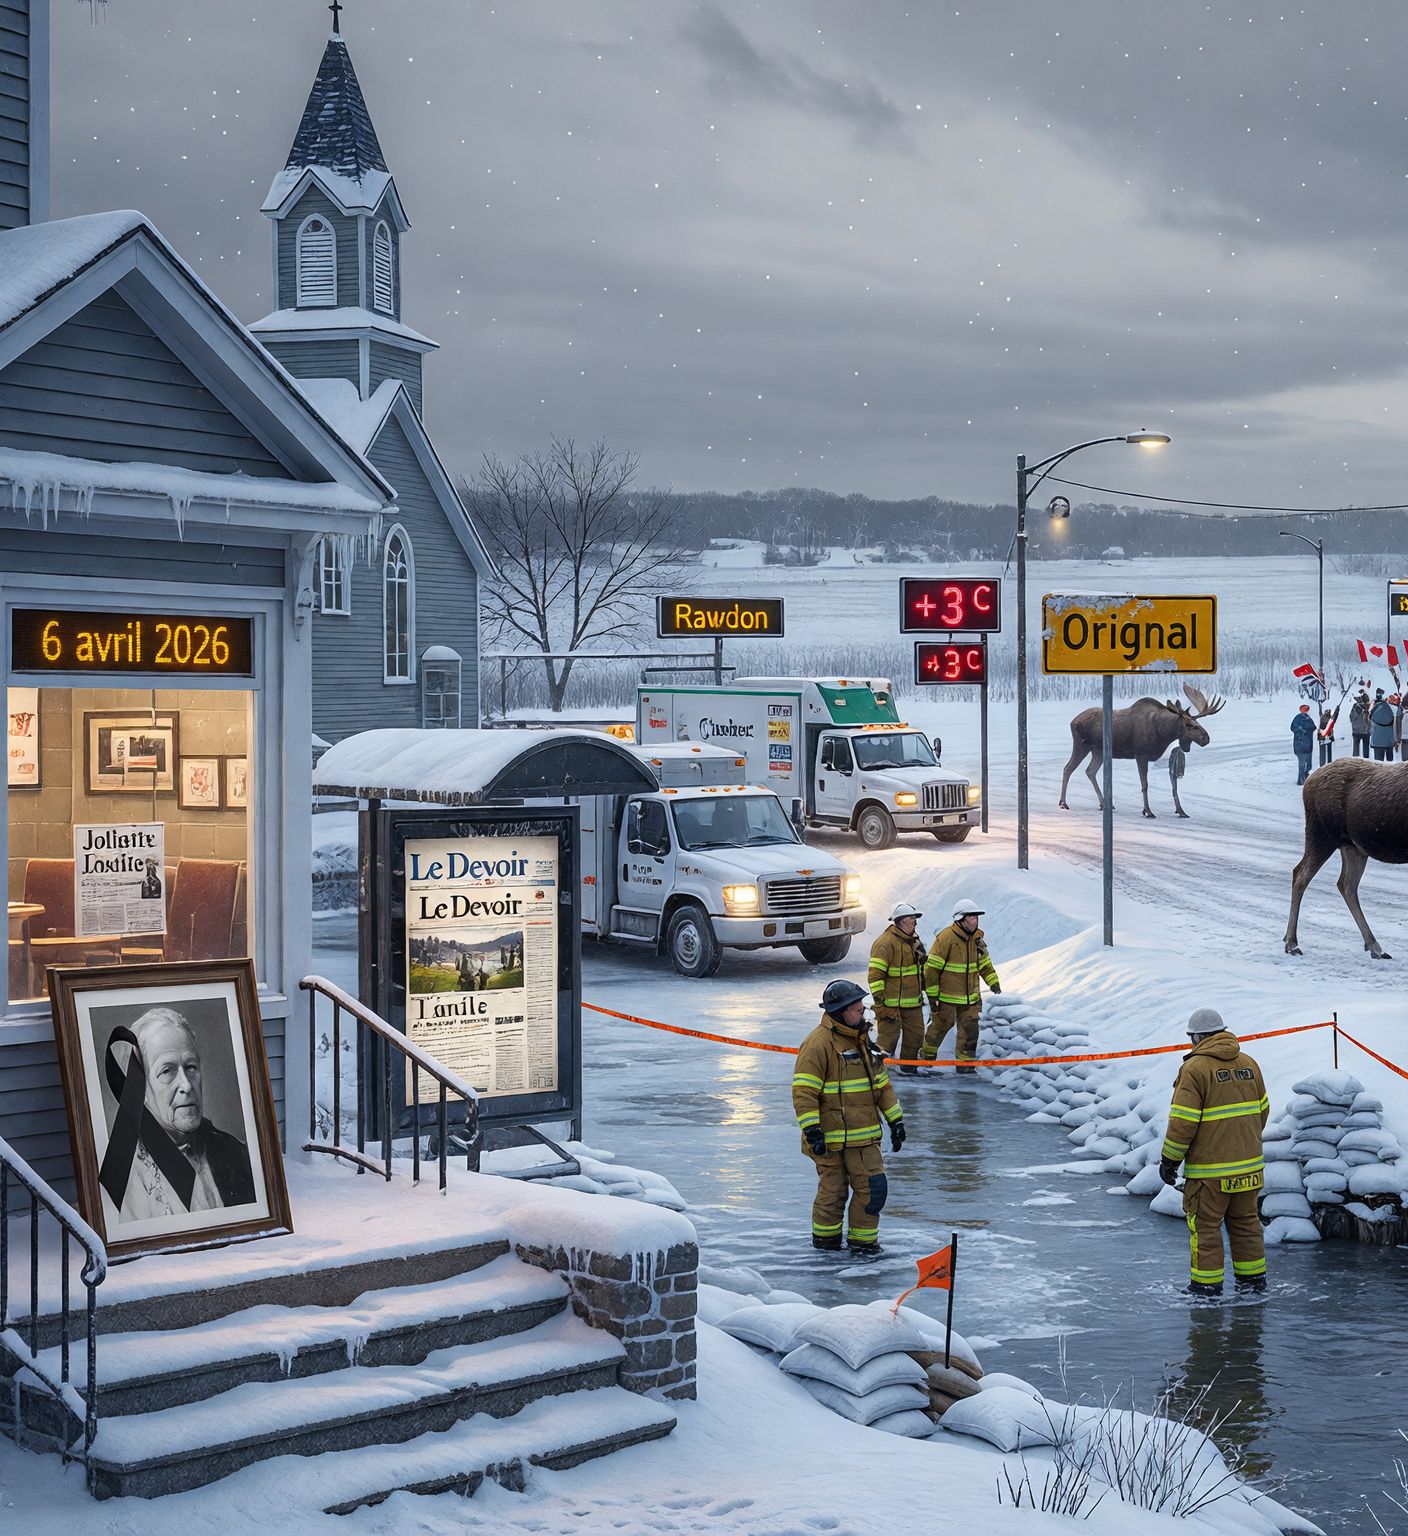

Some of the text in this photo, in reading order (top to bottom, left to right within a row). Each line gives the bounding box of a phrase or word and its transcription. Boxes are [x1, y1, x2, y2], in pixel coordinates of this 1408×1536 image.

[675, 603, 769, 629] Rawdon
[42, 620, 230, 664] 6 avril 2026
[1063, 613, 1197, 661] Orignal
[410, 853, 443, 881] Le
[447, 850, 529, 880] Devoir
[419, 892, 523, 920] Le Devoir
